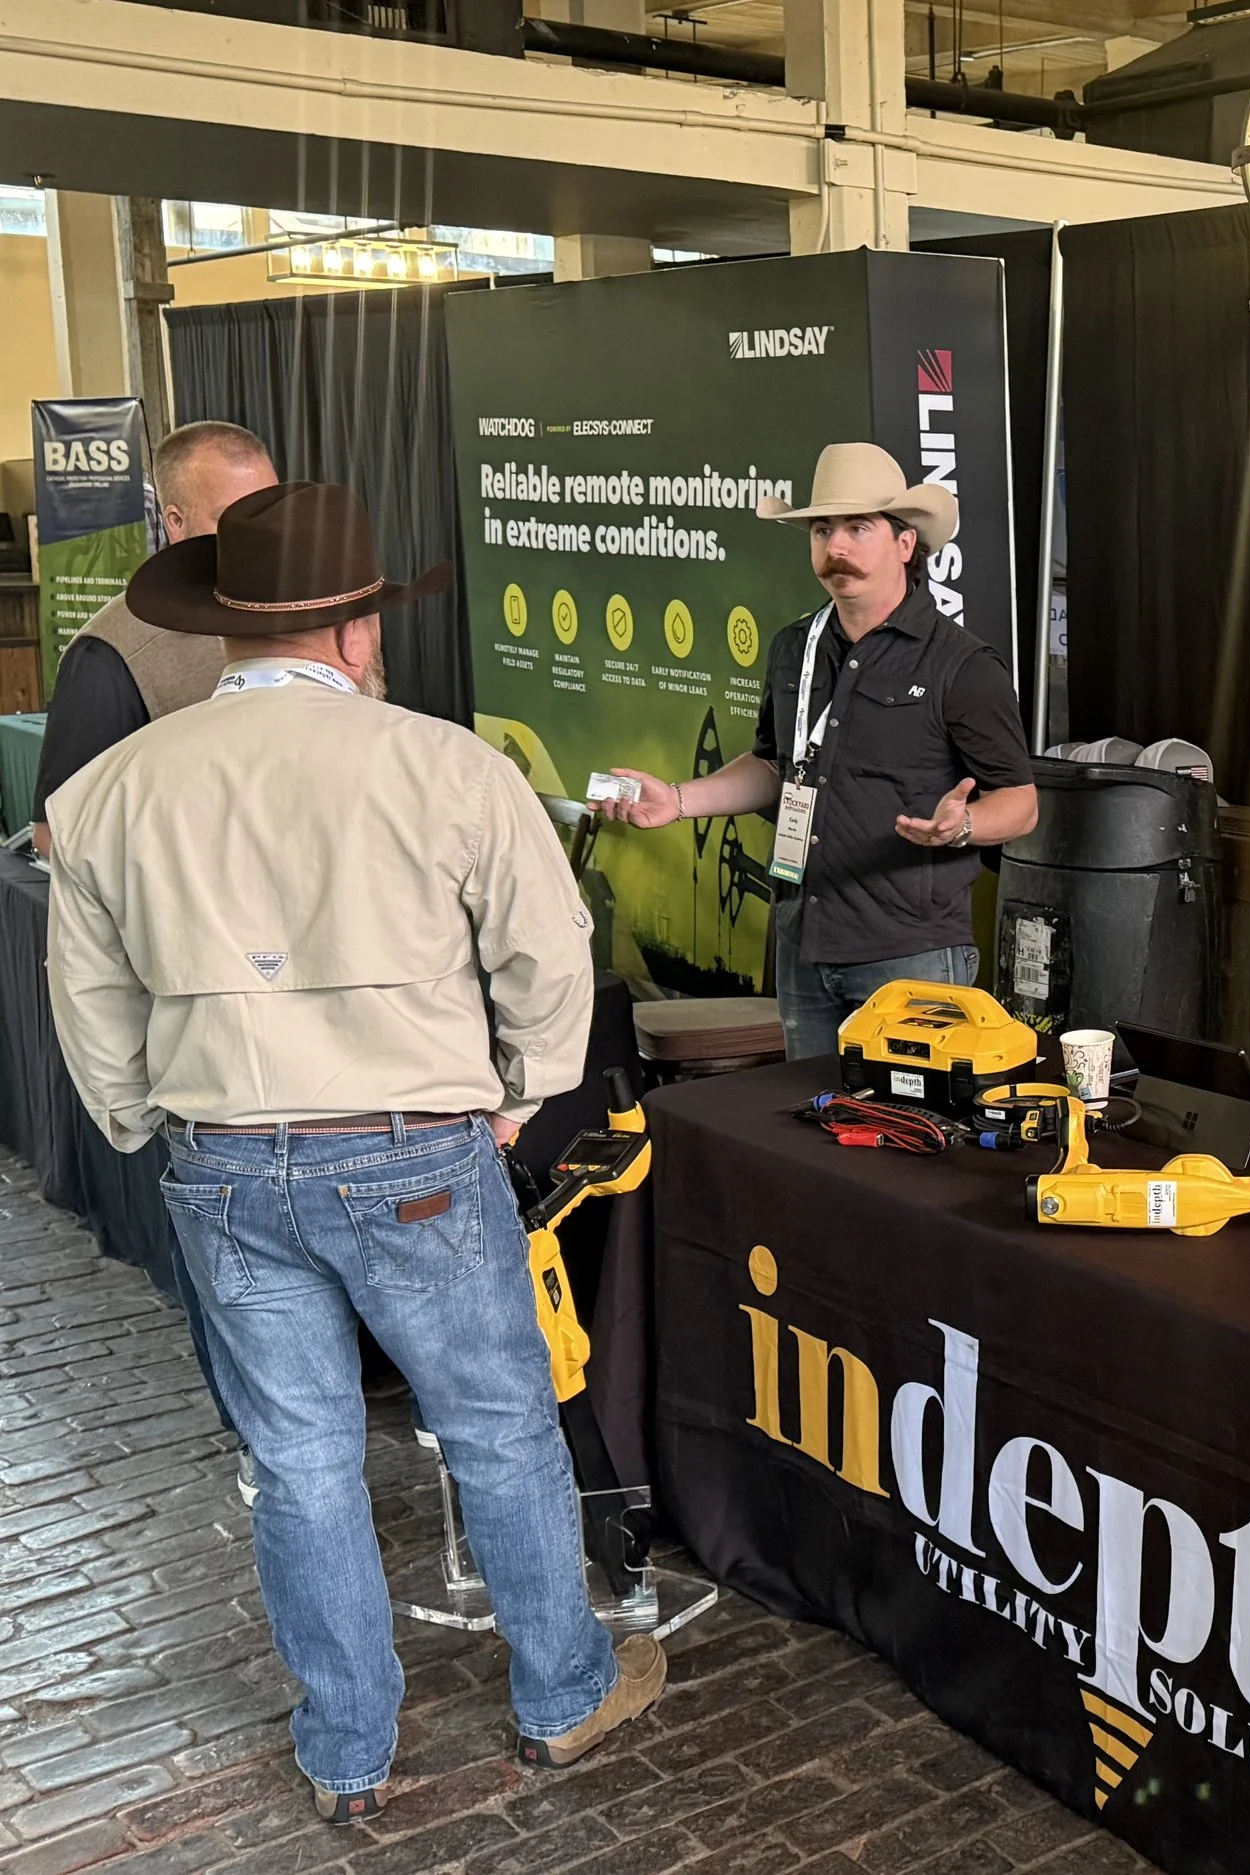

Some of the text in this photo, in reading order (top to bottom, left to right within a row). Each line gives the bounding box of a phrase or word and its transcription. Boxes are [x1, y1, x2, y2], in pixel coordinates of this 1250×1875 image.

[742, 326, 828, 358] LINDSAY
[479, 418, 535, 437] WATCHDOG
[44, 440, 129, 471] BASS
[481, 462, 561, 503] Reliable
[565, 470, 645, 506] remote
[918, 394, 964, 627] LINSA
[484, 507, 726, 561] in extreme conditions.
[605, 660, 639, 671] SECURE 24/7
[652, 666, 711, 681] EARLY NOTIFICATION
[659, 681, 707, 696] OF MINOR LEAKS
[730, 677, 760, 689] INCREASE
[914, 1531, 1091, 1667] UTILITY
